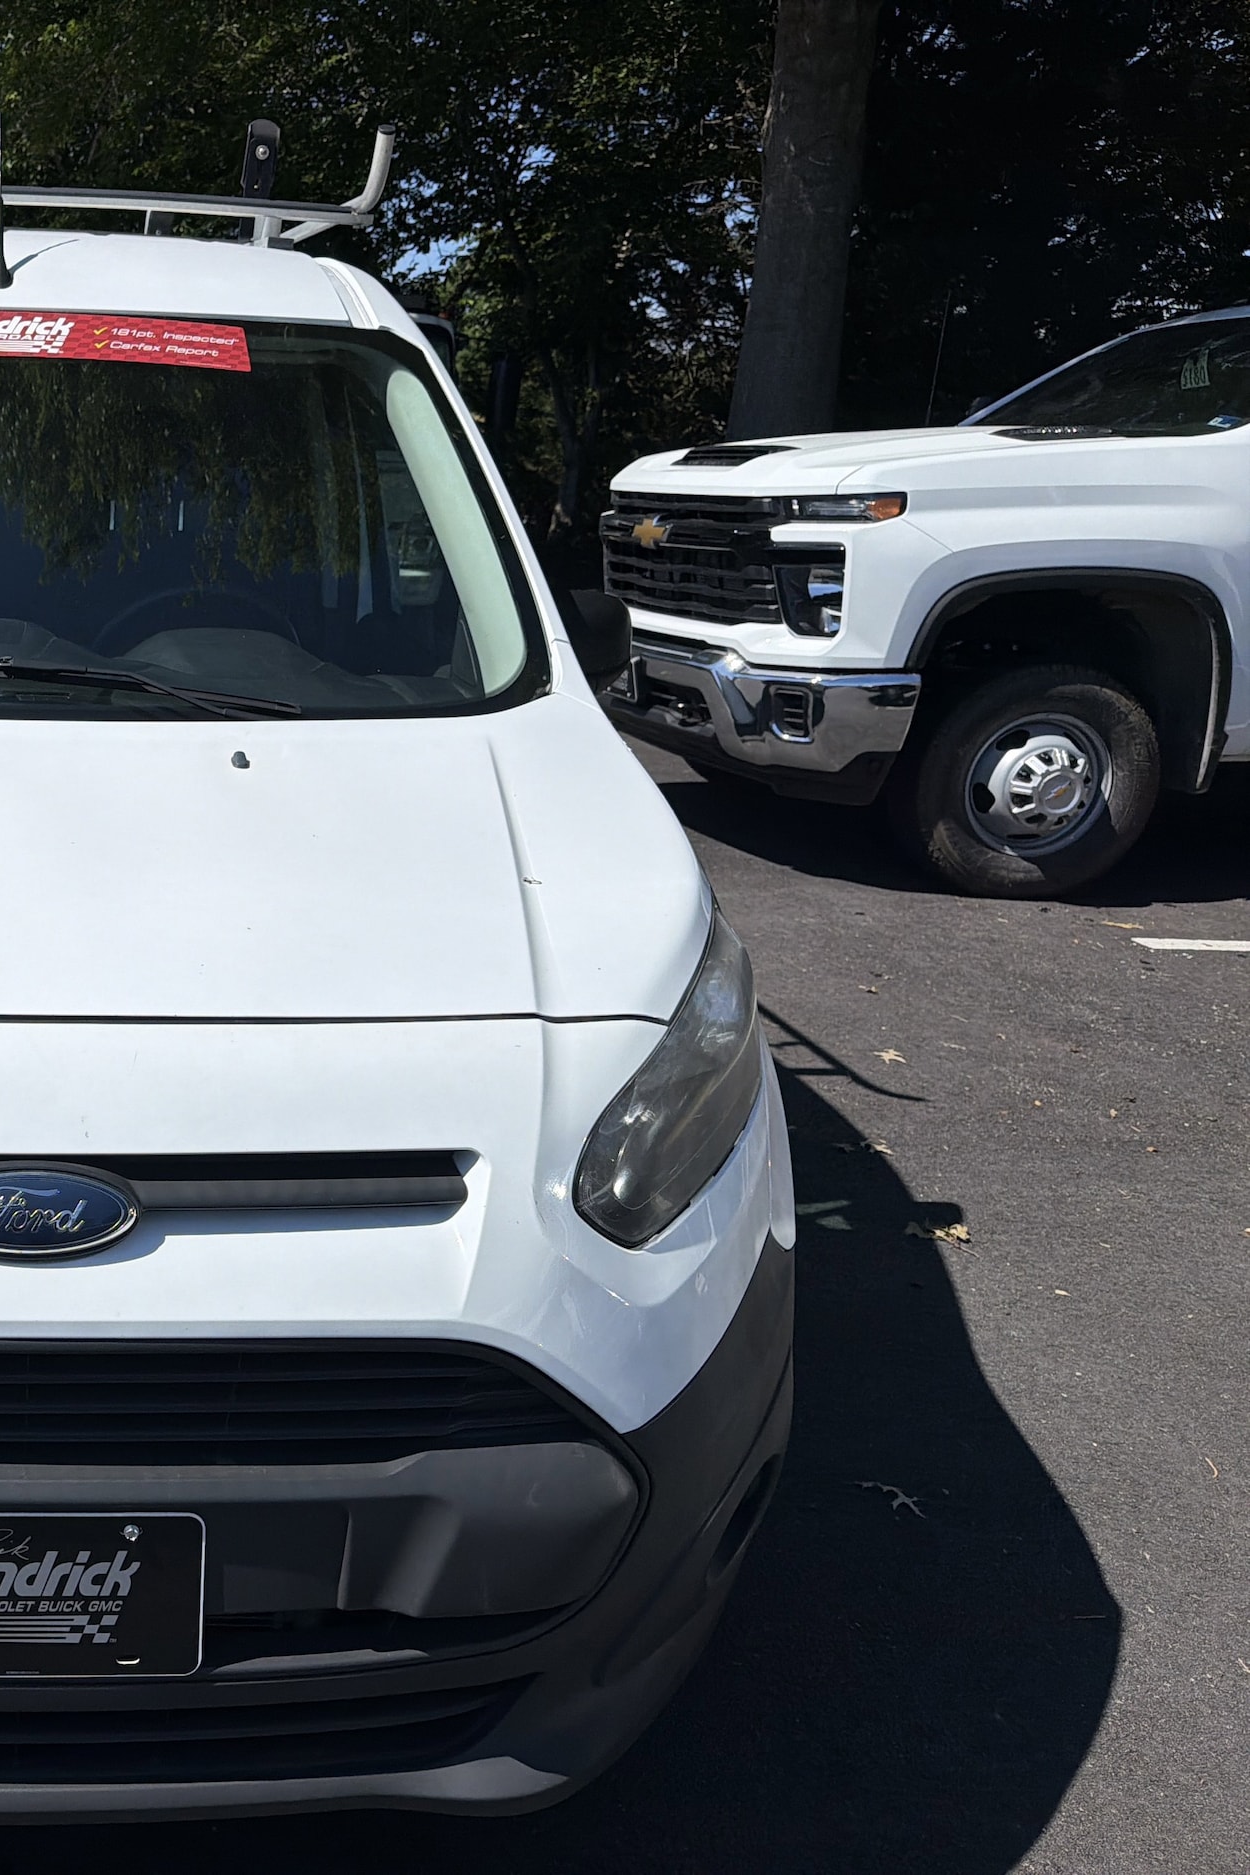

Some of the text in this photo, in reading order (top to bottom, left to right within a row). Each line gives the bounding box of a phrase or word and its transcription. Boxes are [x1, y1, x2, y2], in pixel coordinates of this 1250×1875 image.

[109, 341, 220, 357] Carfax Report
[38, 1600, 85, 1613] BUICK
[88, 1600, 124, 1613] GMC
